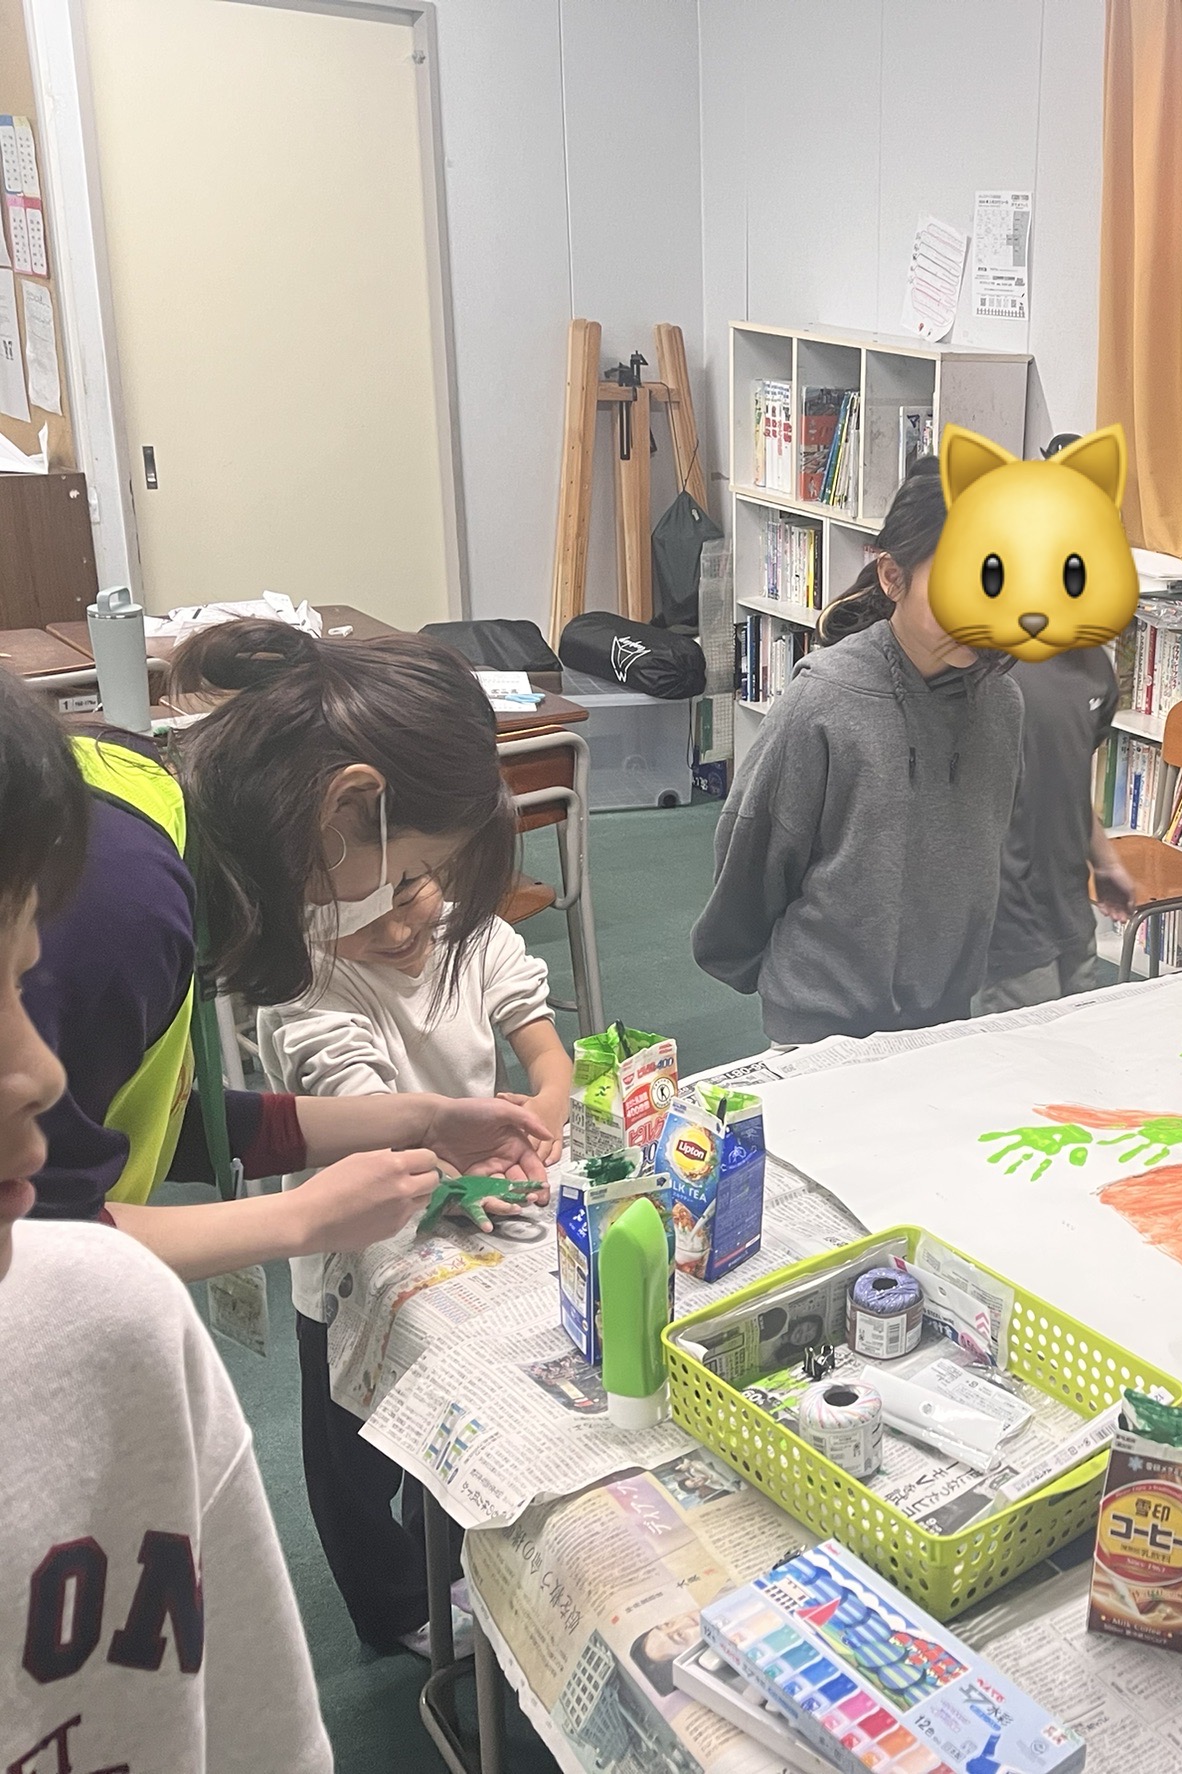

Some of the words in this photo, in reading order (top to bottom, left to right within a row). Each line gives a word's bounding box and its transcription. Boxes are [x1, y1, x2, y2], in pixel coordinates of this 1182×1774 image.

[678, 1141, 705, 1159] Lipton
[688, 1187, 707, 1203] TEA
[1134, 1497, 1171, 1522] 雪印
[913, 1713, 936, 1739] 12色
